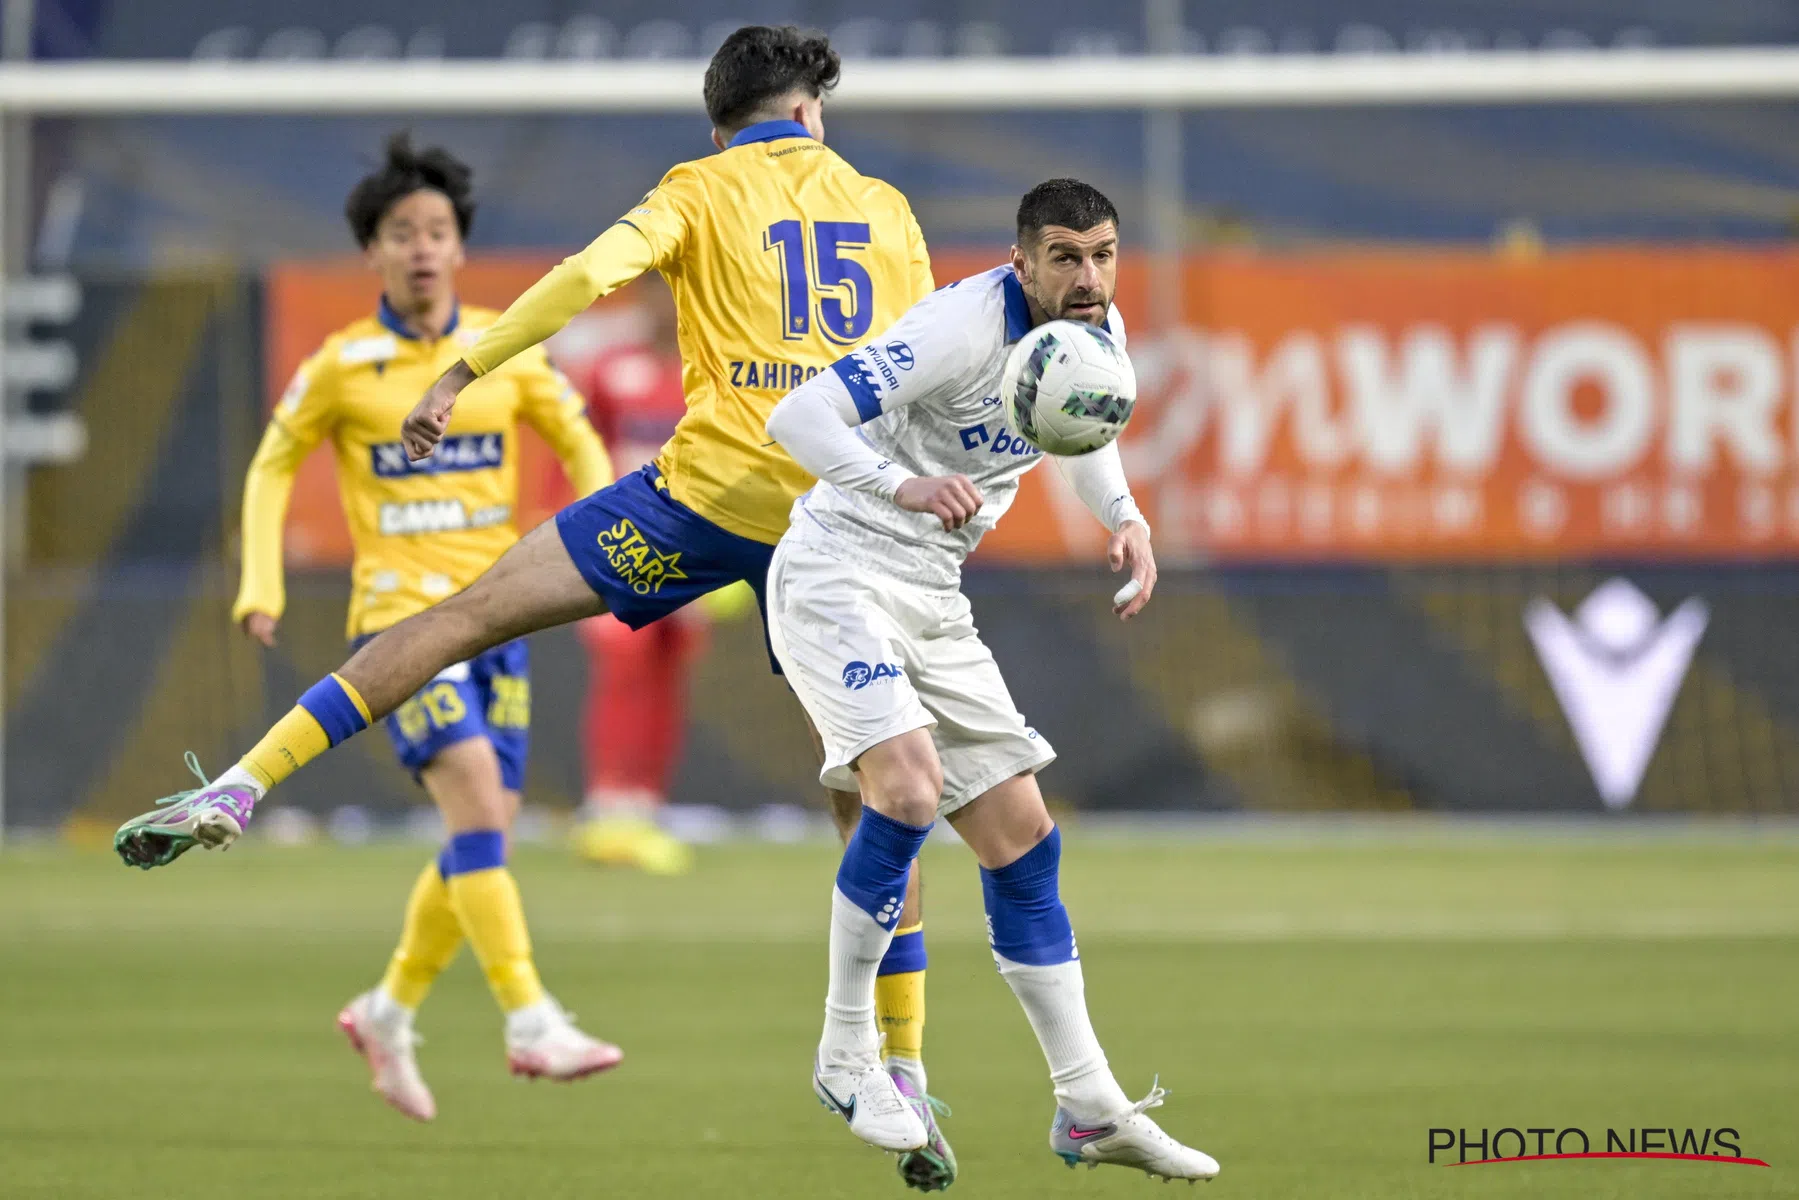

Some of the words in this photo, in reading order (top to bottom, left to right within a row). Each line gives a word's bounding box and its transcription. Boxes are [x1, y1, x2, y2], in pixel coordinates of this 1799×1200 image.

[763, 219, 873, 346] 15
[730, 361, 831, 389] ZAHIRO
[865, 345, 900, 391] HYUNDAI
[597, 530, 650, 595] CASINO
[611, 518, 664, 583] STAR
[422, 682, 468, 729] 13
